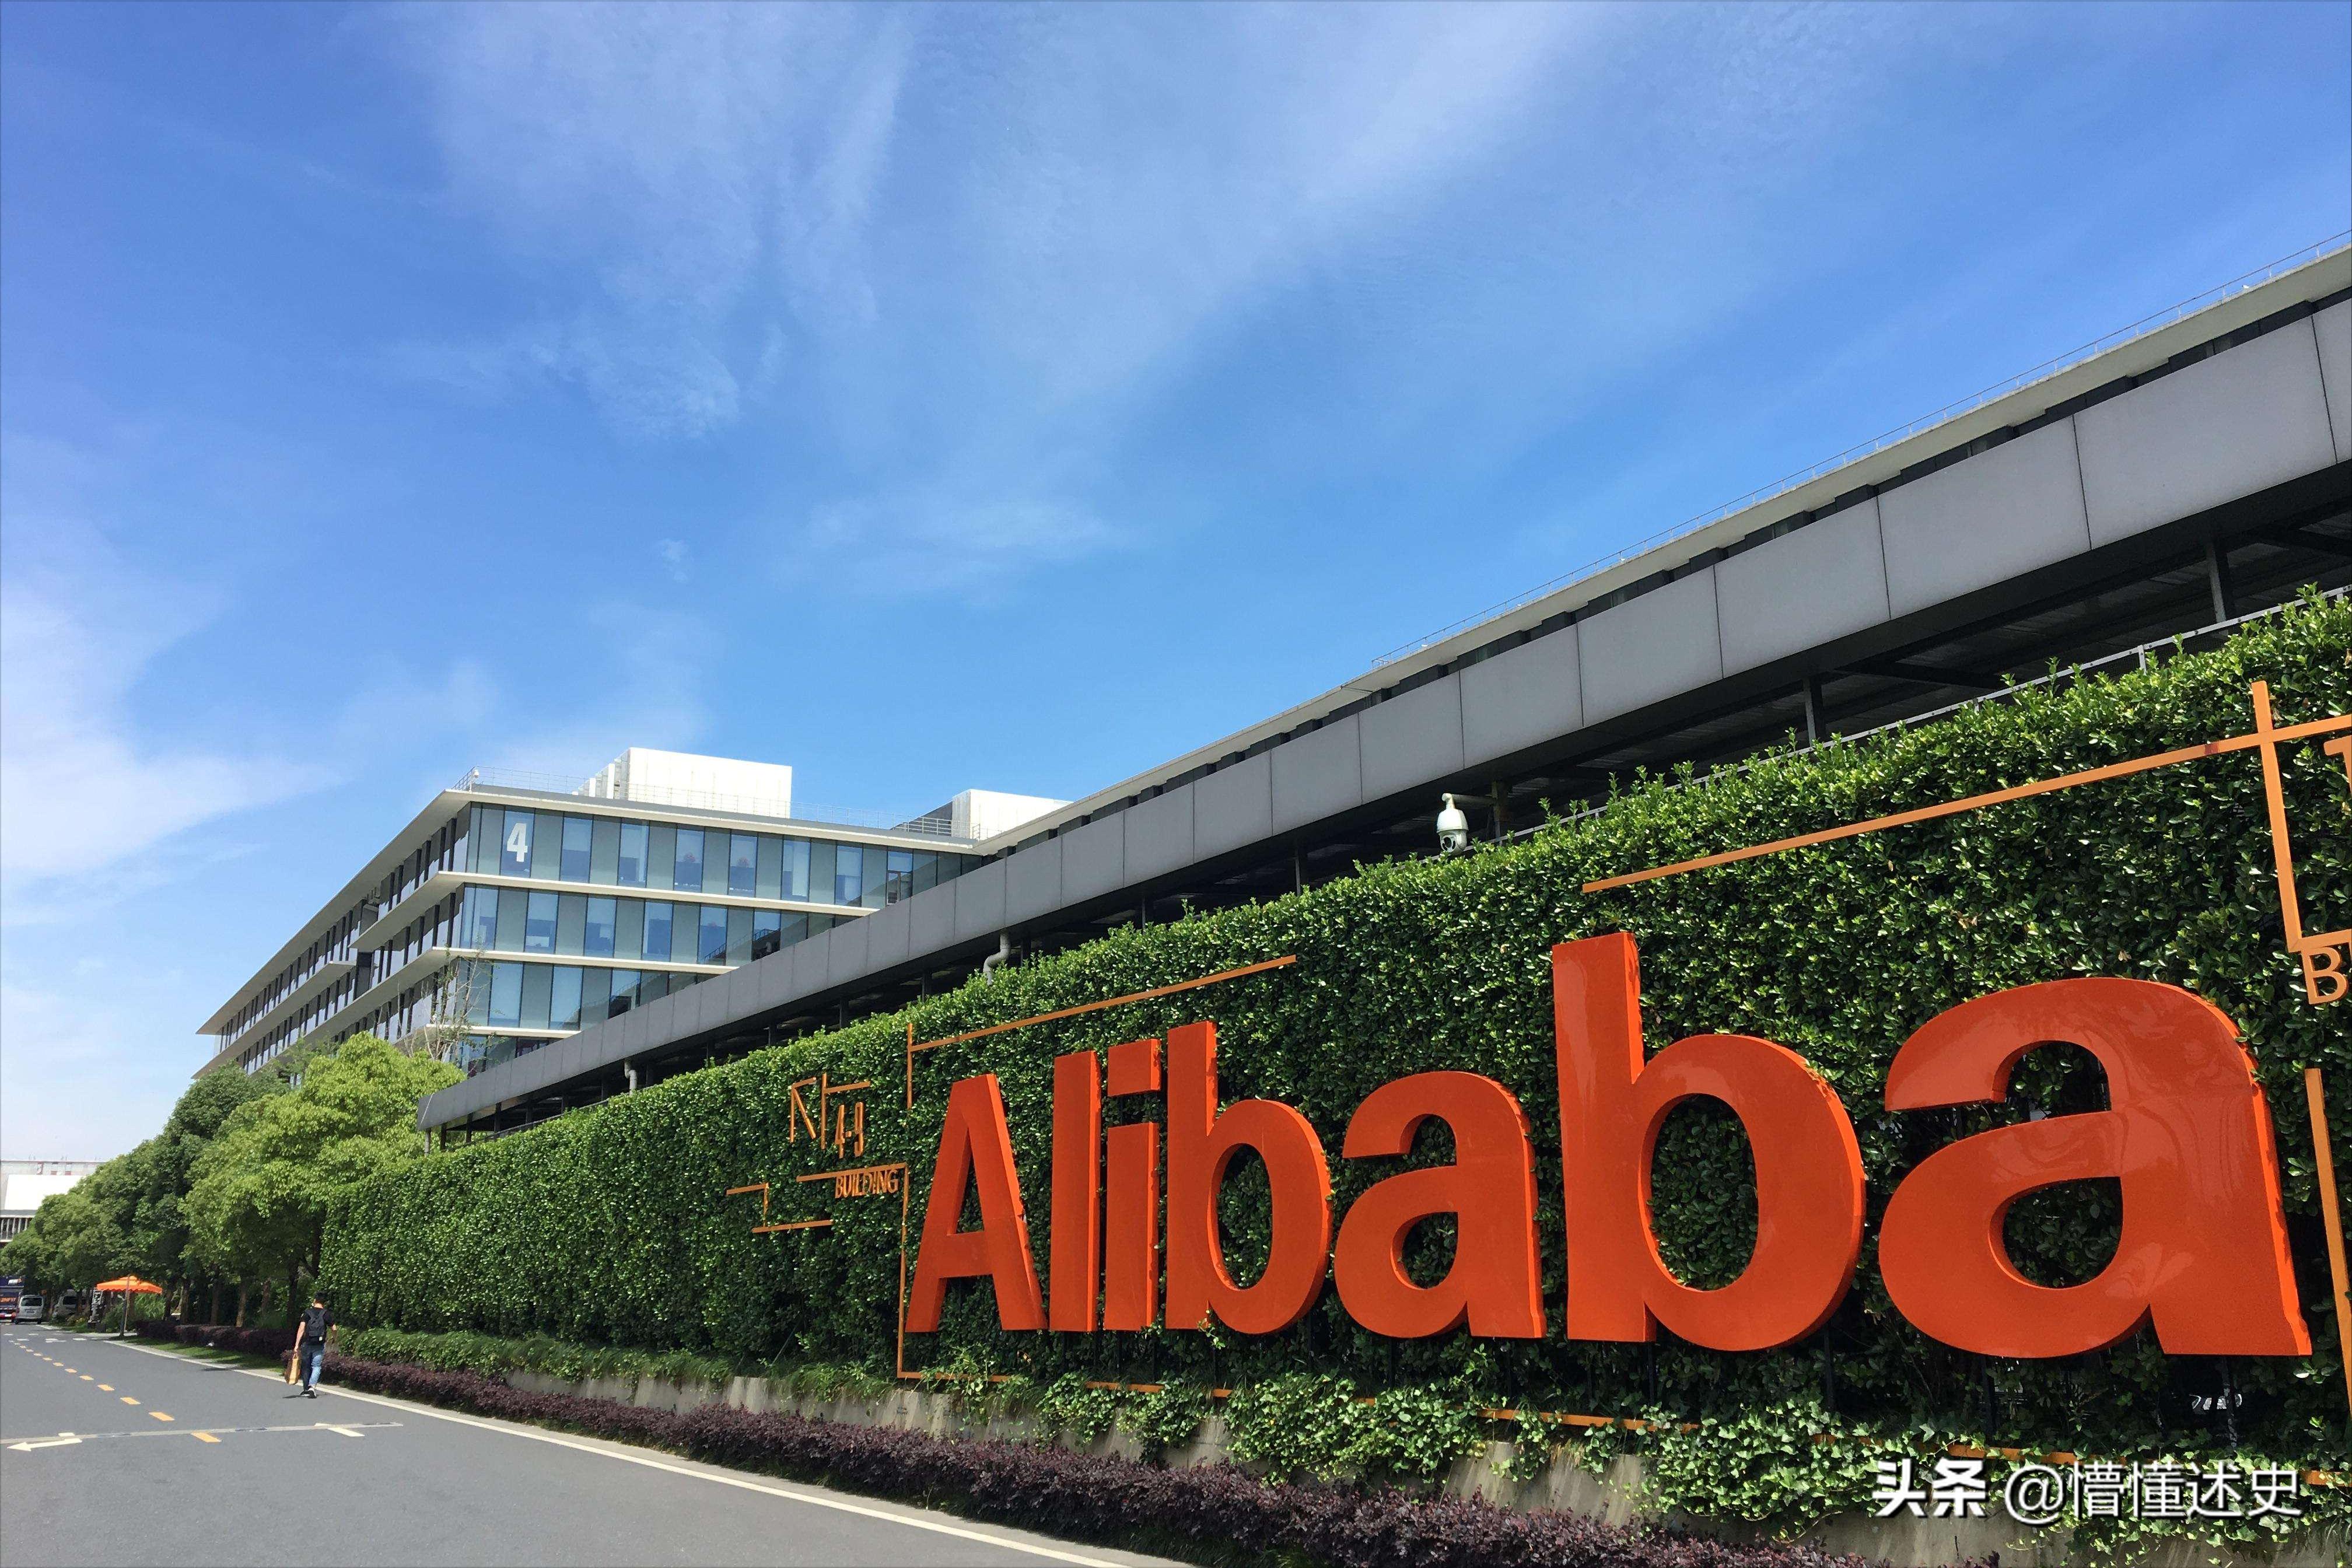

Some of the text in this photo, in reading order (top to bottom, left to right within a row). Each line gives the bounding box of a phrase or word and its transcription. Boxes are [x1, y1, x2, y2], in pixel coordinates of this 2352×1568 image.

[507, 823, 527, 862] 4
[906, 932, 2313, 1358] Alibaba
[835, 1169, 898, 1198] BUILDING
